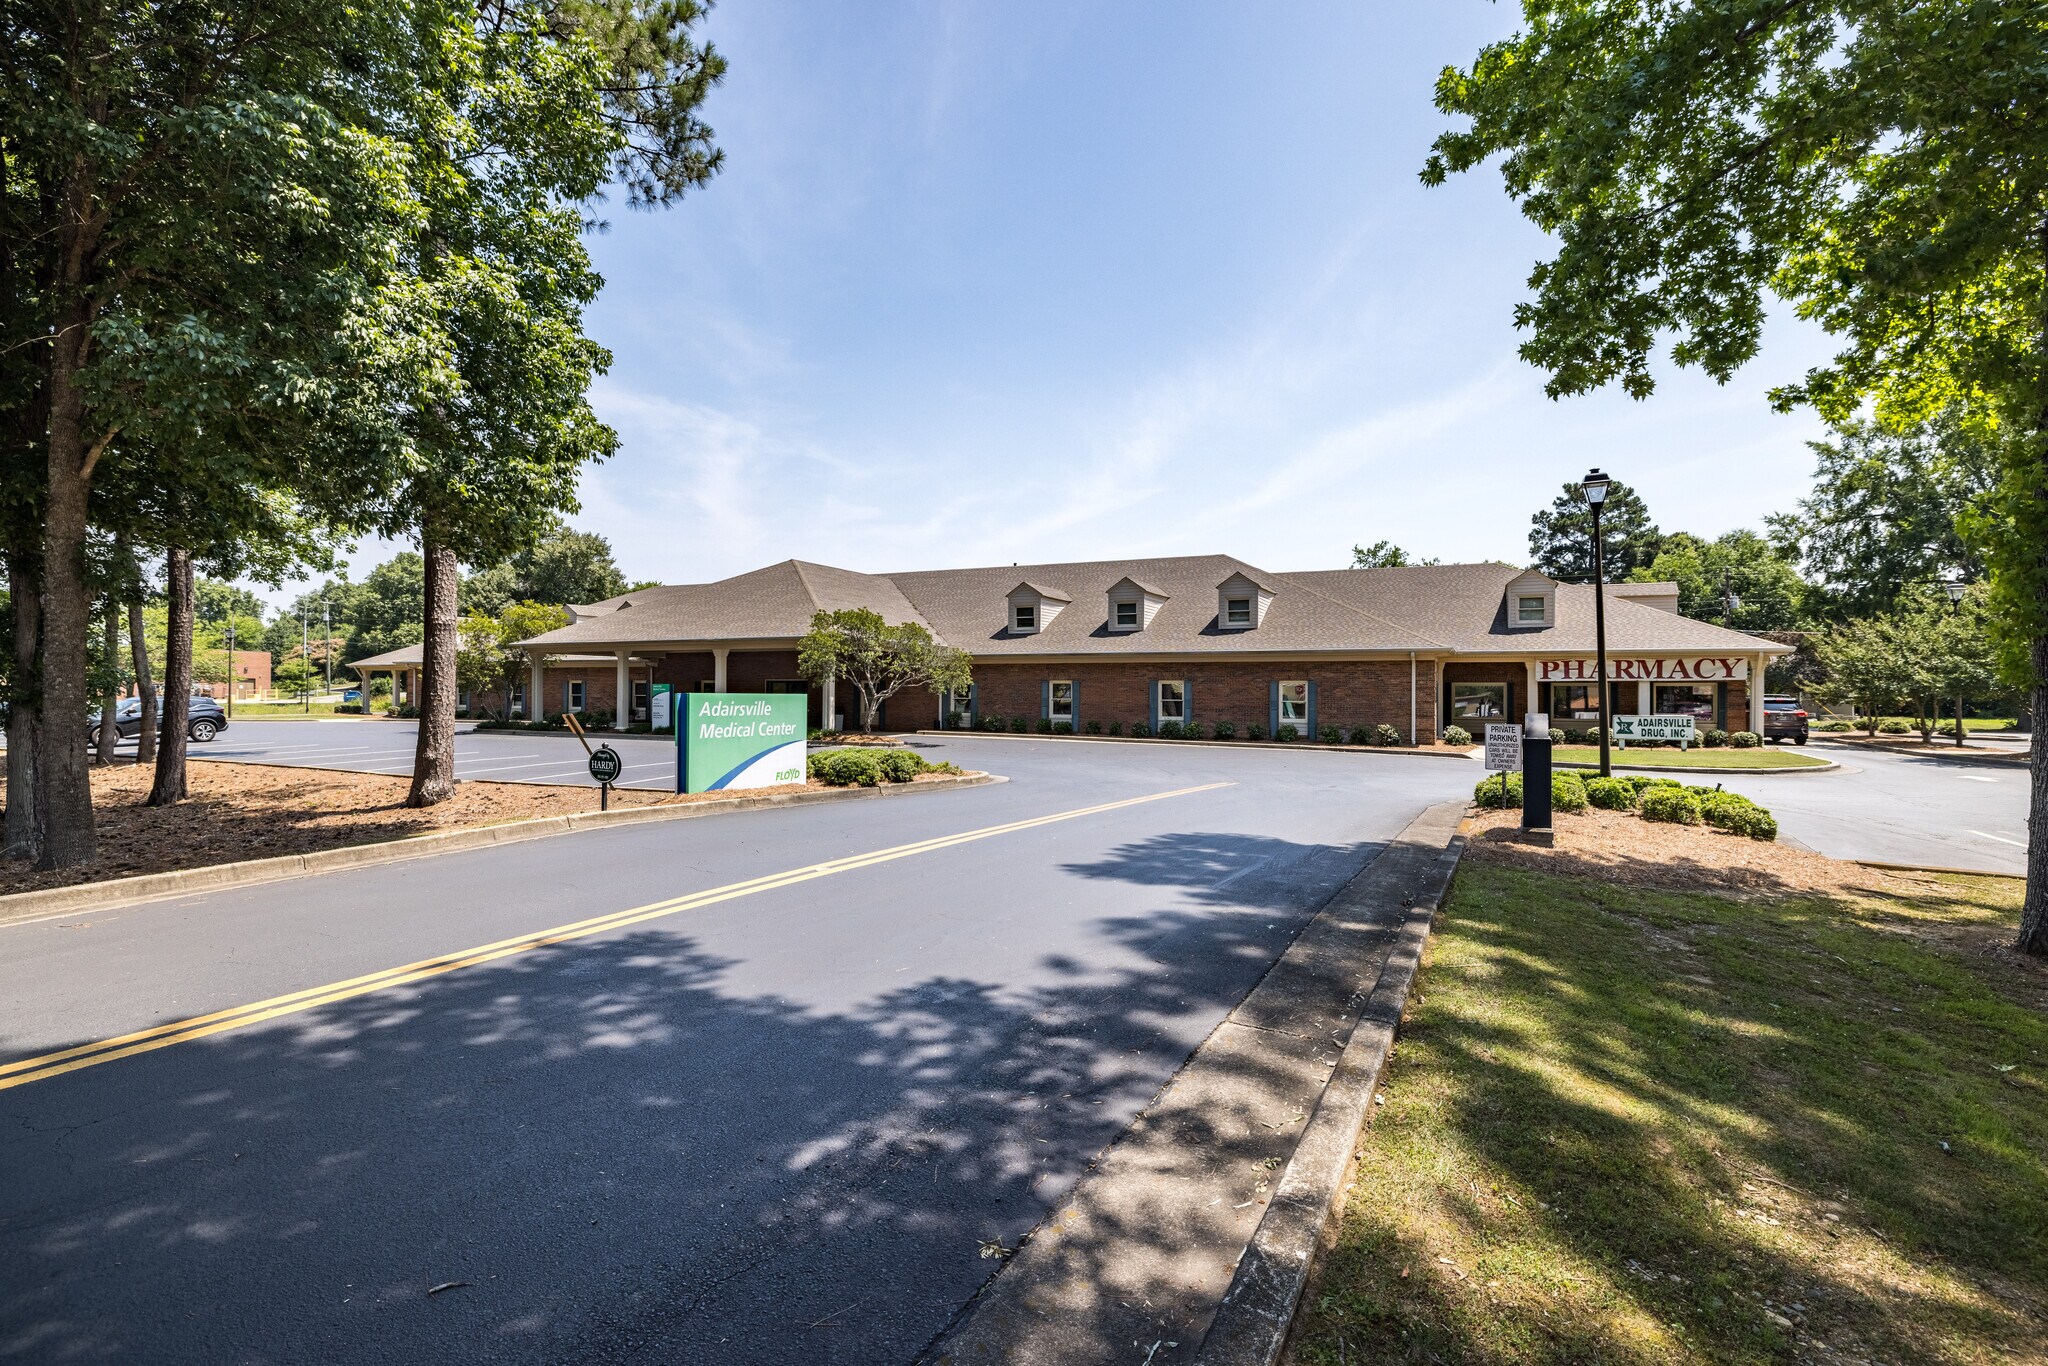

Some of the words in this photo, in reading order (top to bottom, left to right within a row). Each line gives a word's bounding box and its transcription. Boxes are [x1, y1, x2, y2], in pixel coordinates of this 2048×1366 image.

[698, 700, 772, 717] Adairsville
[1637, 718, 1692, 728] ADAIRSVILLE
[699, 721, 756, 739] Medical
[758, 721, 797, 737] Center
[1490, 725, 1516, 734] PRIVATE
[1670, 728, 1689, 738] INC.
[1489, 734, 1518, 743] PARKING
[591, 760, 615, 770] HARDY
[775, 768, 800, 781] FLOYD
